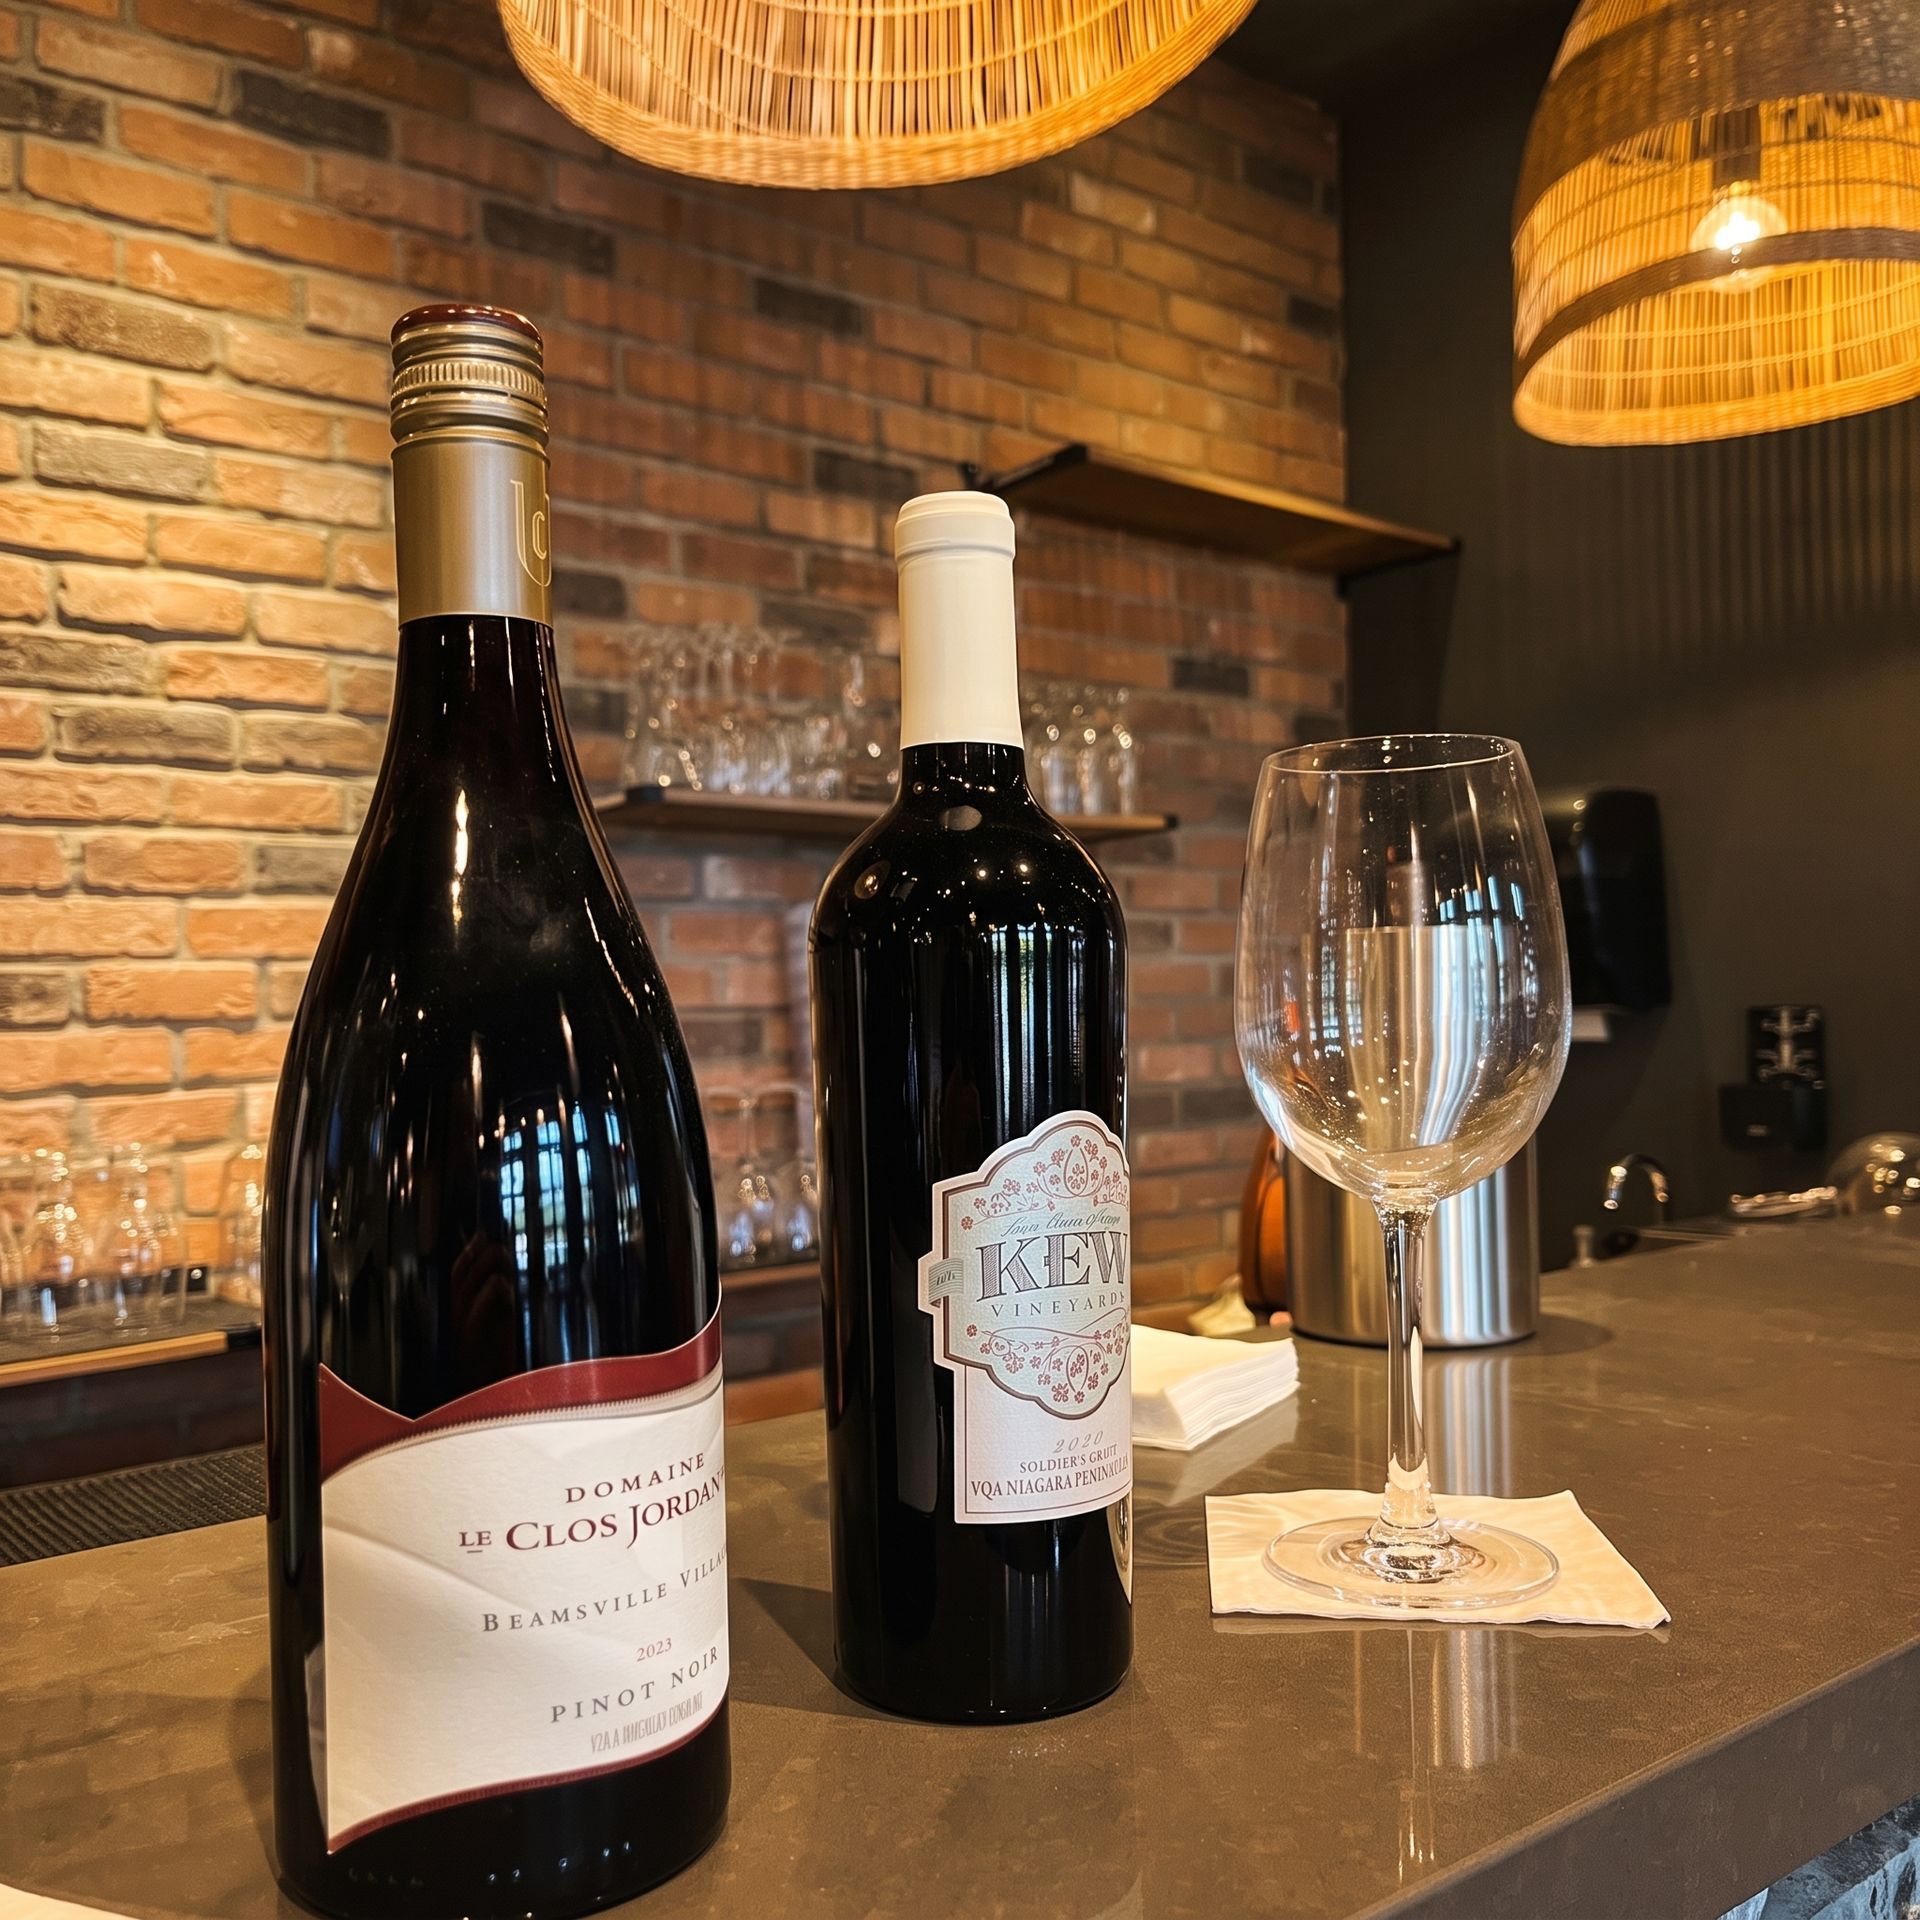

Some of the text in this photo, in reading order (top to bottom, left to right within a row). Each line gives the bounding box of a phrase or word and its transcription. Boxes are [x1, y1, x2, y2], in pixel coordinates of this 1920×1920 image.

[975, 1231, 1128, 1302] KEW
[1053, 1430, 1104, 1454] 2020
[565, 1452, 704, 1504] DOMAINE
[1019, 1454, 1086, 1474] SOLDIER'S
[971, 1480, 1003, 1501] VQA
[1006, 1473, 1073, 1496] NIAGARA
[458, 1530, 492, 1548] LE
[506, 1514, 618, 1551] CLOS
[482, 1582, 667, 1632] BEAMSVILLE
[637, 1637, 672, 1662] 2023
[551, 1681, 655, 1723] PINOT
[670, 1646, 718, 1689] NOIR
